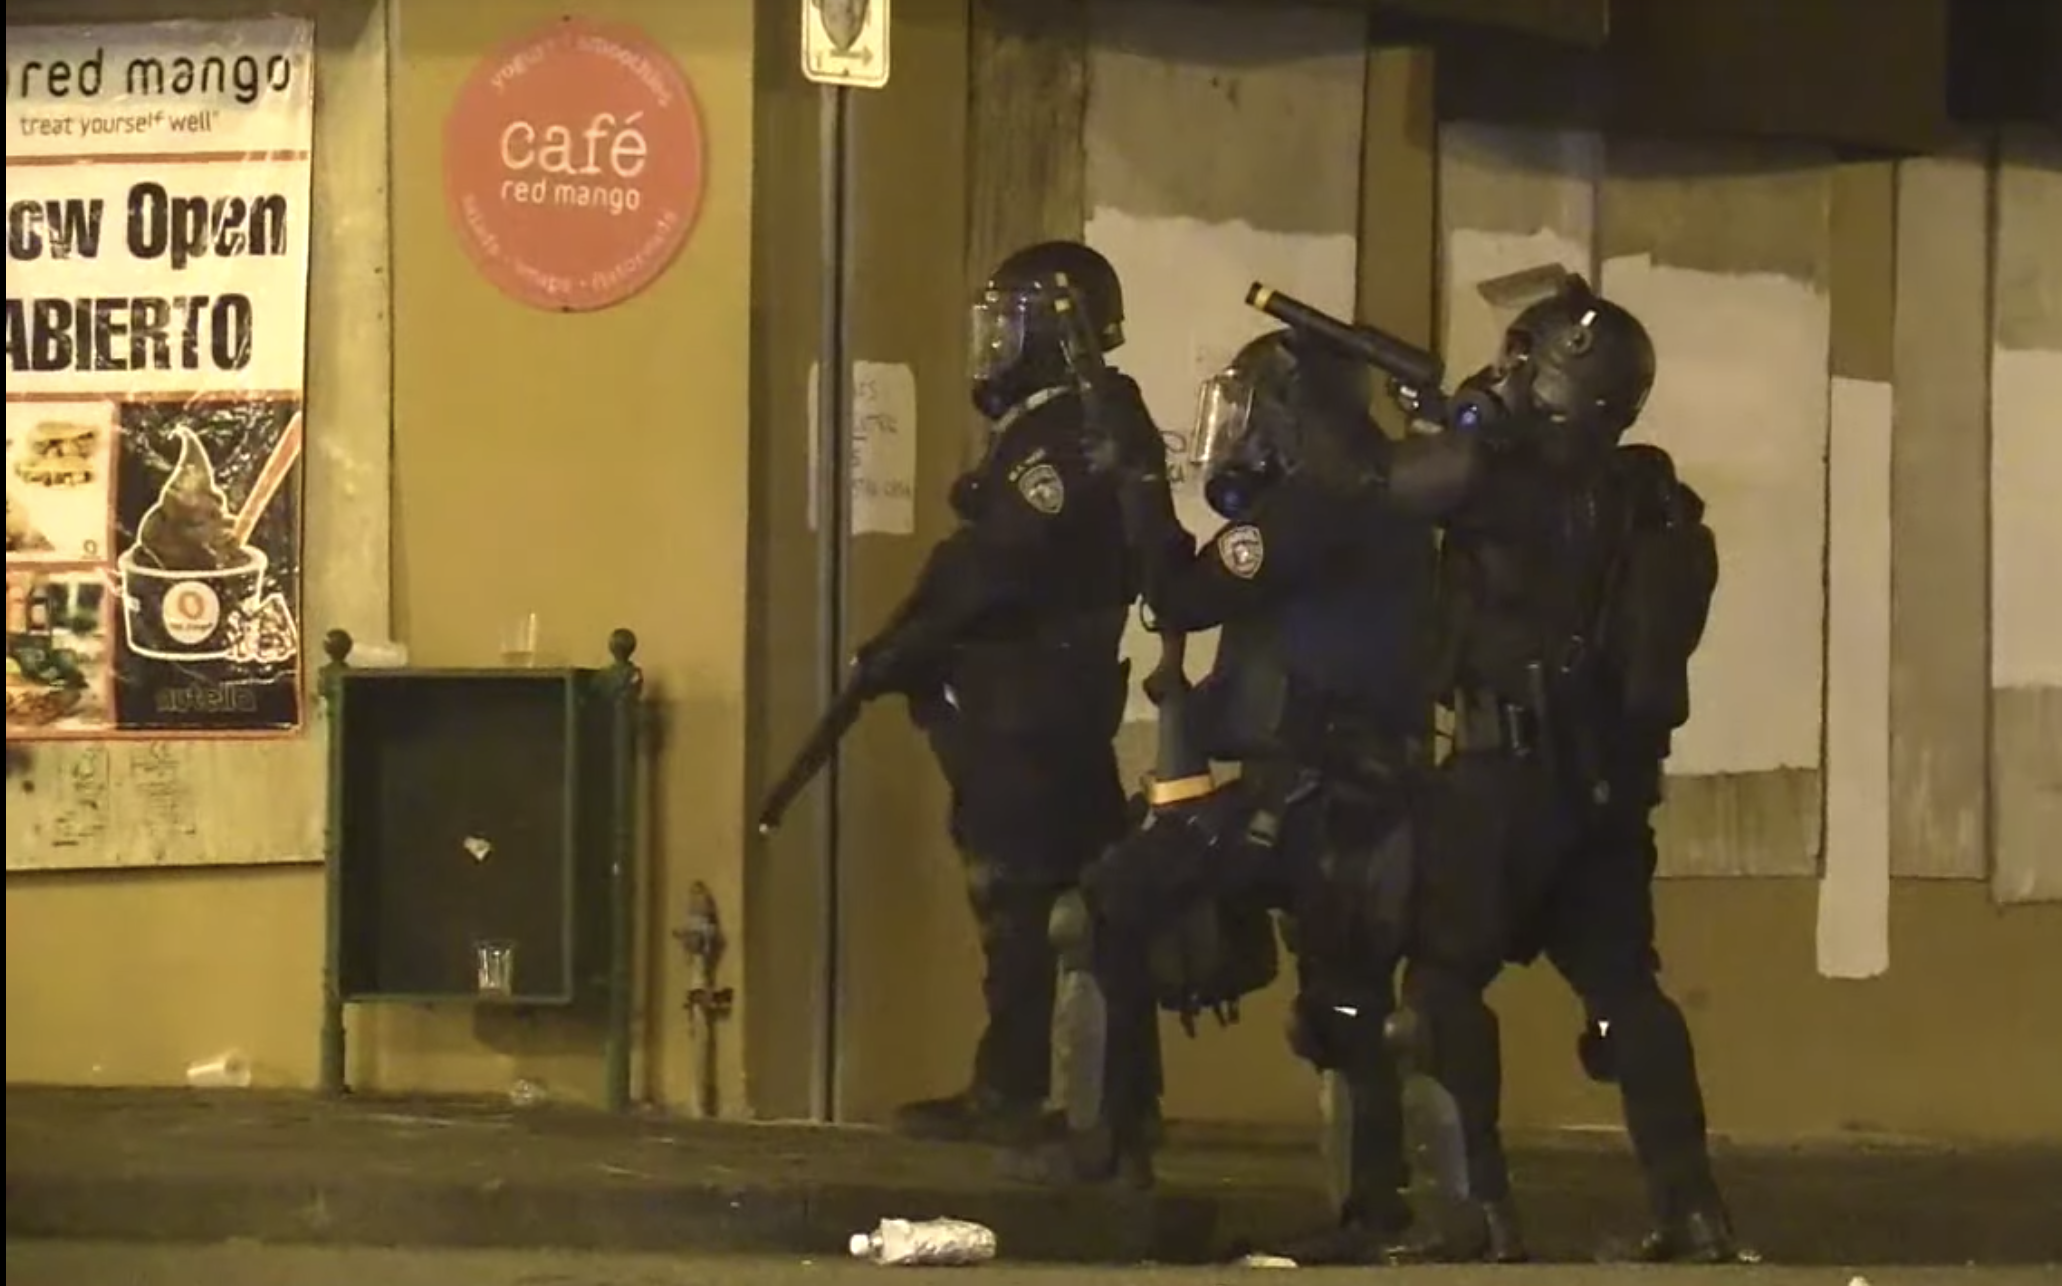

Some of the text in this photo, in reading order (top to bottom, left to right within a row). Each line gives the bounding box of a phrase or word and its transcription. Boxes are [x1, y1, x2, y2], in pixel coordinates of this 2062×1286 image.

[21, 47, 291, 104] red mango
[20, 116, 73, 136] treat
[80, 110, 165, 137] yourself
[501, 110, 648, 179] café
[127, 181, 287, 270] Open
[501, 179, 641, 216] red mango
[6, 293, 252, 372] ABIERTO
